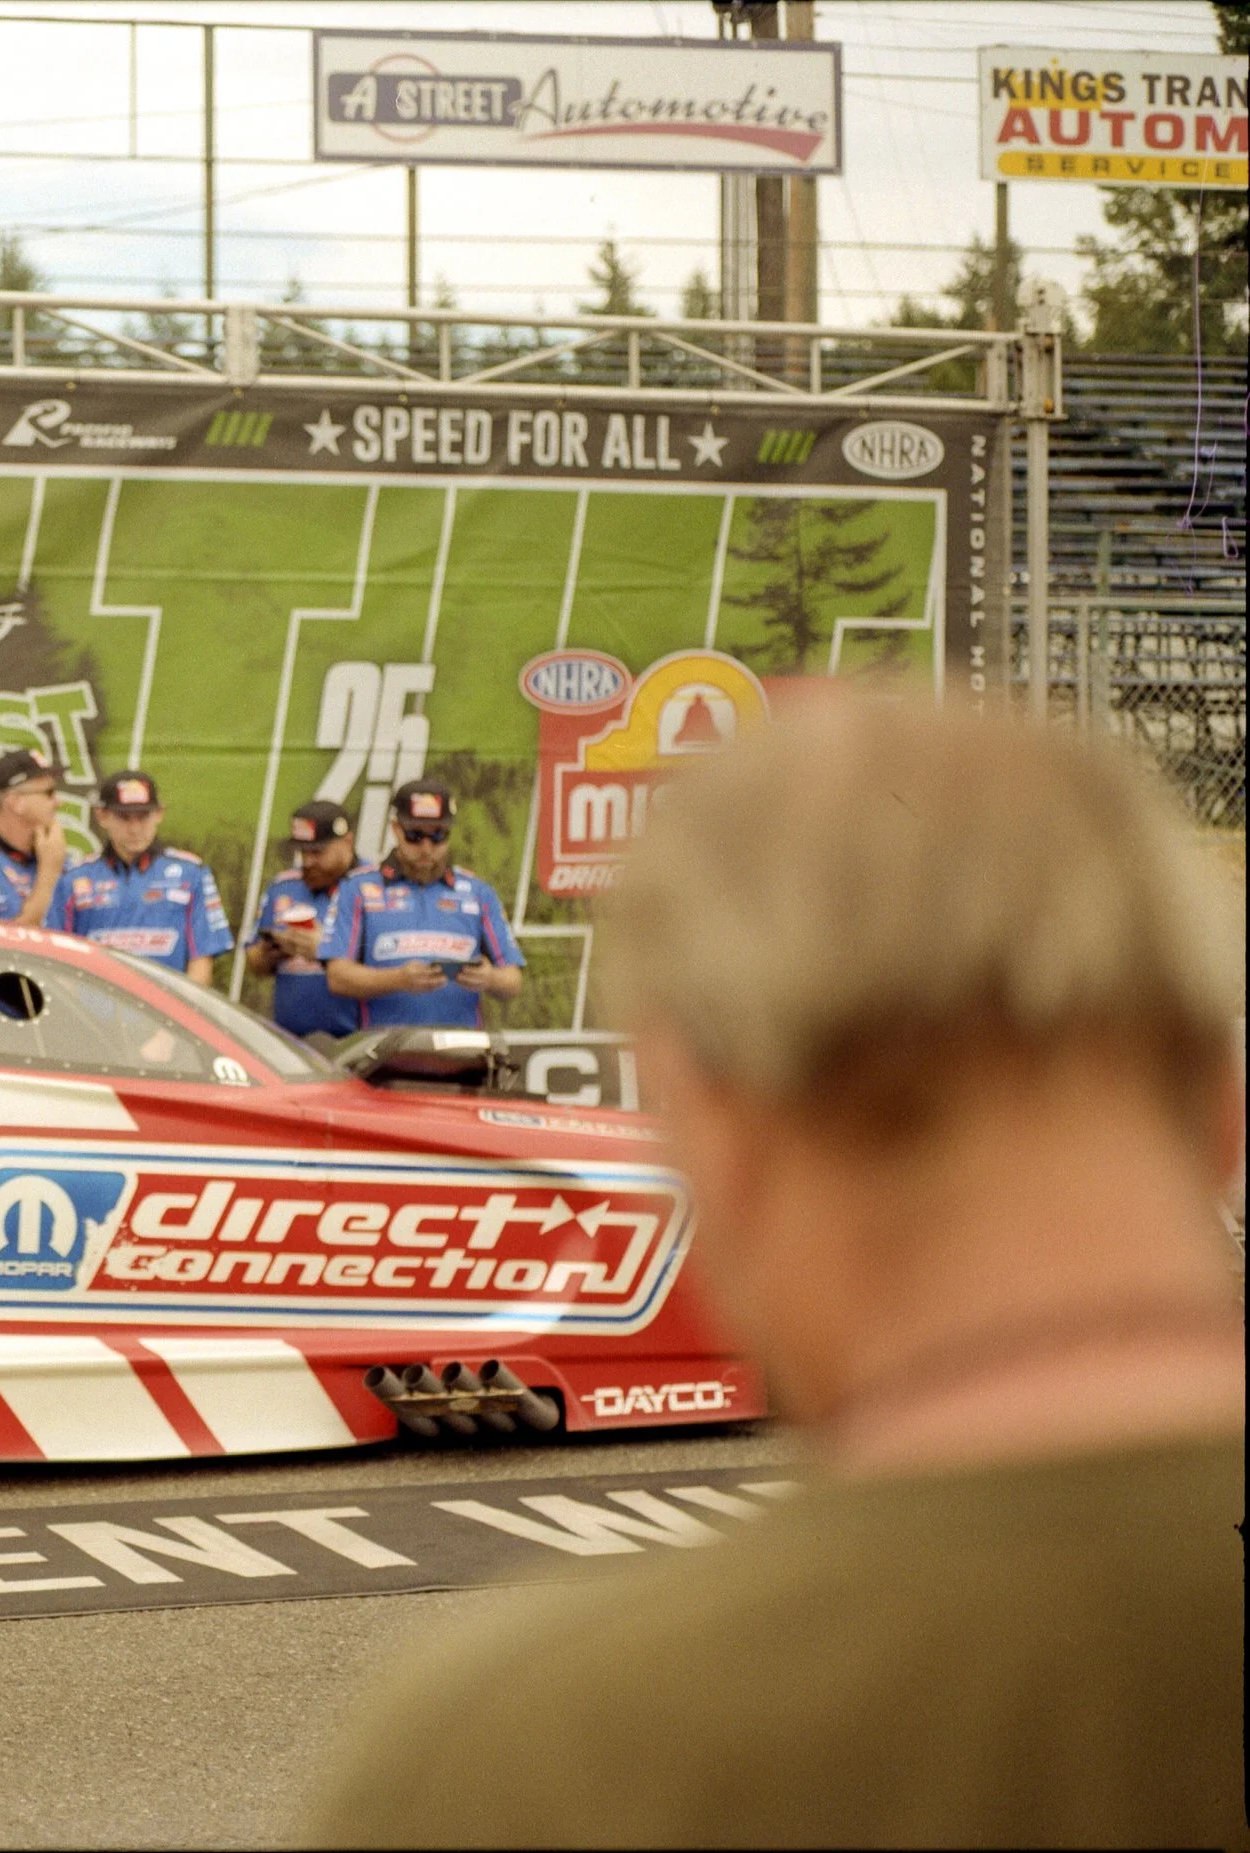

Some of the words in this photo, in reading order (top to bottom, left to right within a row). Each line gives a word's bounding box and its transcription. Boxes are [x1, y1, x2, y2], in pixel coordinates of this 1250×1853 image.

[342, 76, 378, 121] A
[396, 80, 508, 123] STREET
[509, 67, 830, 136] Automotive
[992, 68, 1126, 103] KINGS
[997, 107, 1248, 152] AUTOM
[1027, 156, 1230, 178] SERVICE
[353, 405, 491, 464] SPEED
[507, 411, 589, 469] FOR
[602, 415, 681, 472] ALL
[859, 427, 932, 468] NHRA
[970, 435, 986, 628] NATIONAL
[532, 660, 620, 704] NHRA
[595, 1381, 727, 1417] DAYCO
